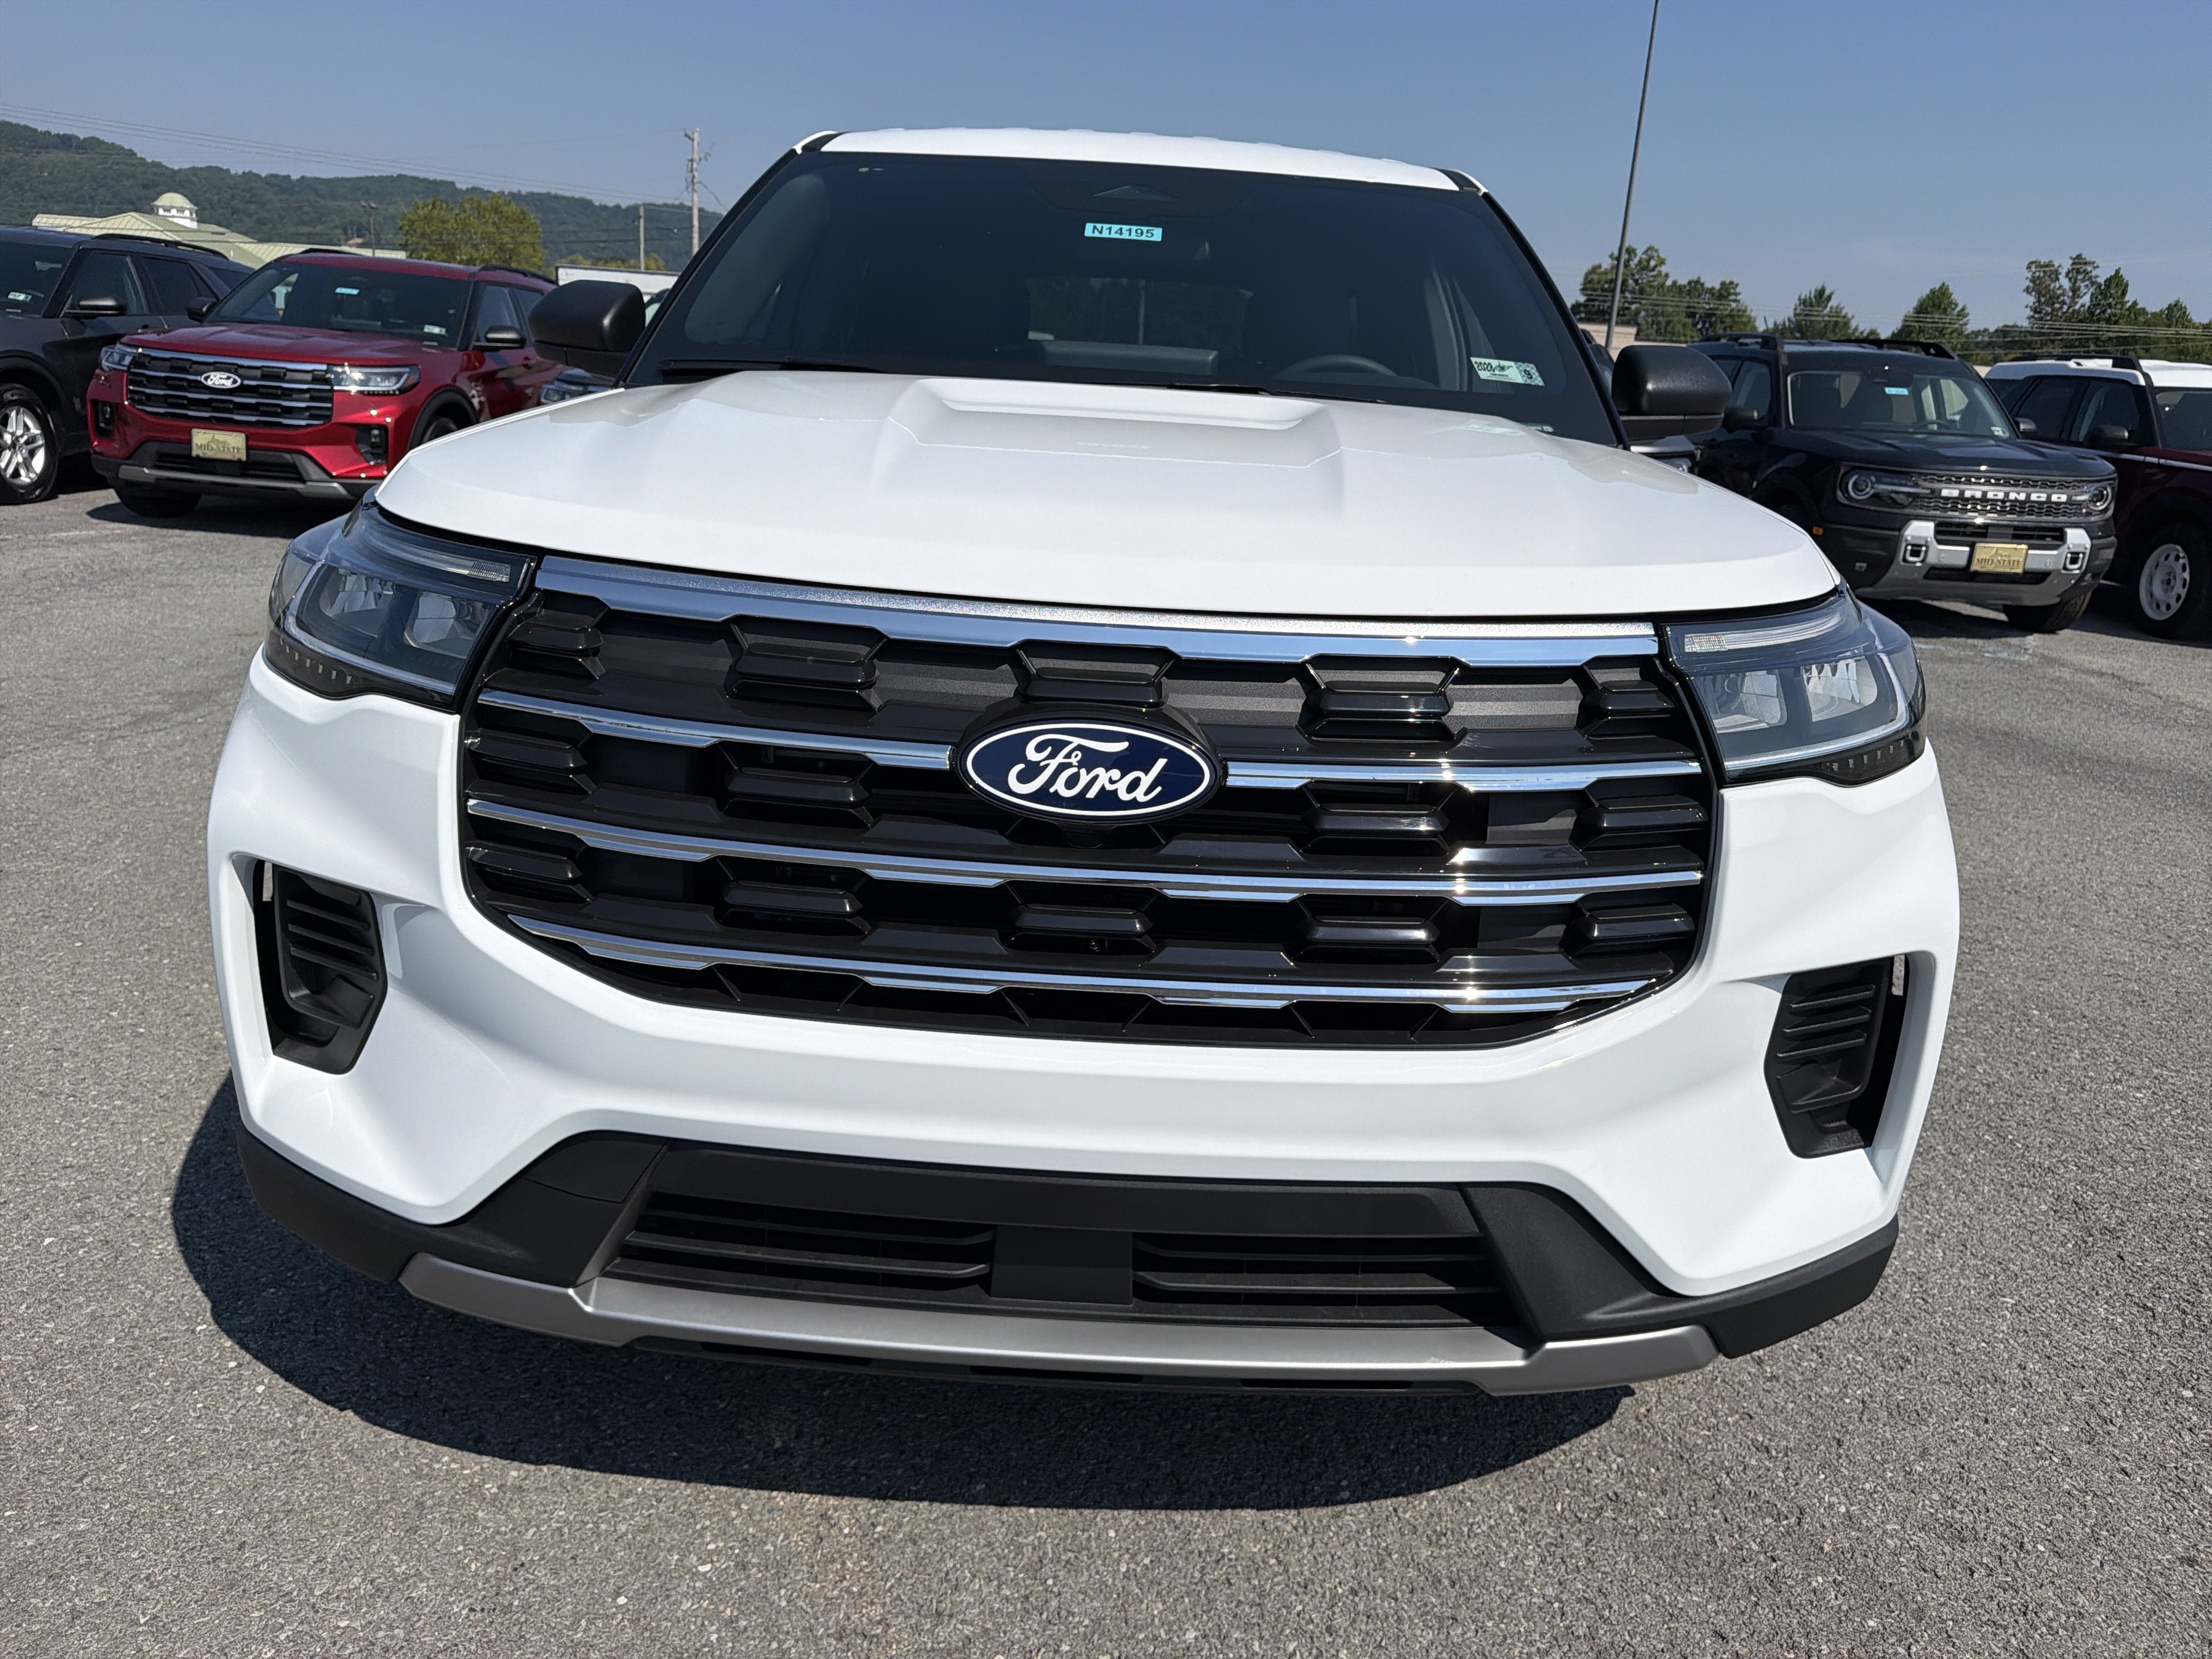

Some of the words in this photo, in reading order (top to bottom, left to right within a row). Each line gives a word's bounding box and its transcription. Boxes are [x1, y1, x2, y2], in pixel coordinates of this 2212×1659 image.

[1092, 224, 1155, 238] N14195
[1474, 361, 1496, 373] 2028
[207, 373, 234, 387] Ford
[1941, 488, 2067, 502] BRONCO
[1008, 733, 1168, 803] Ford
